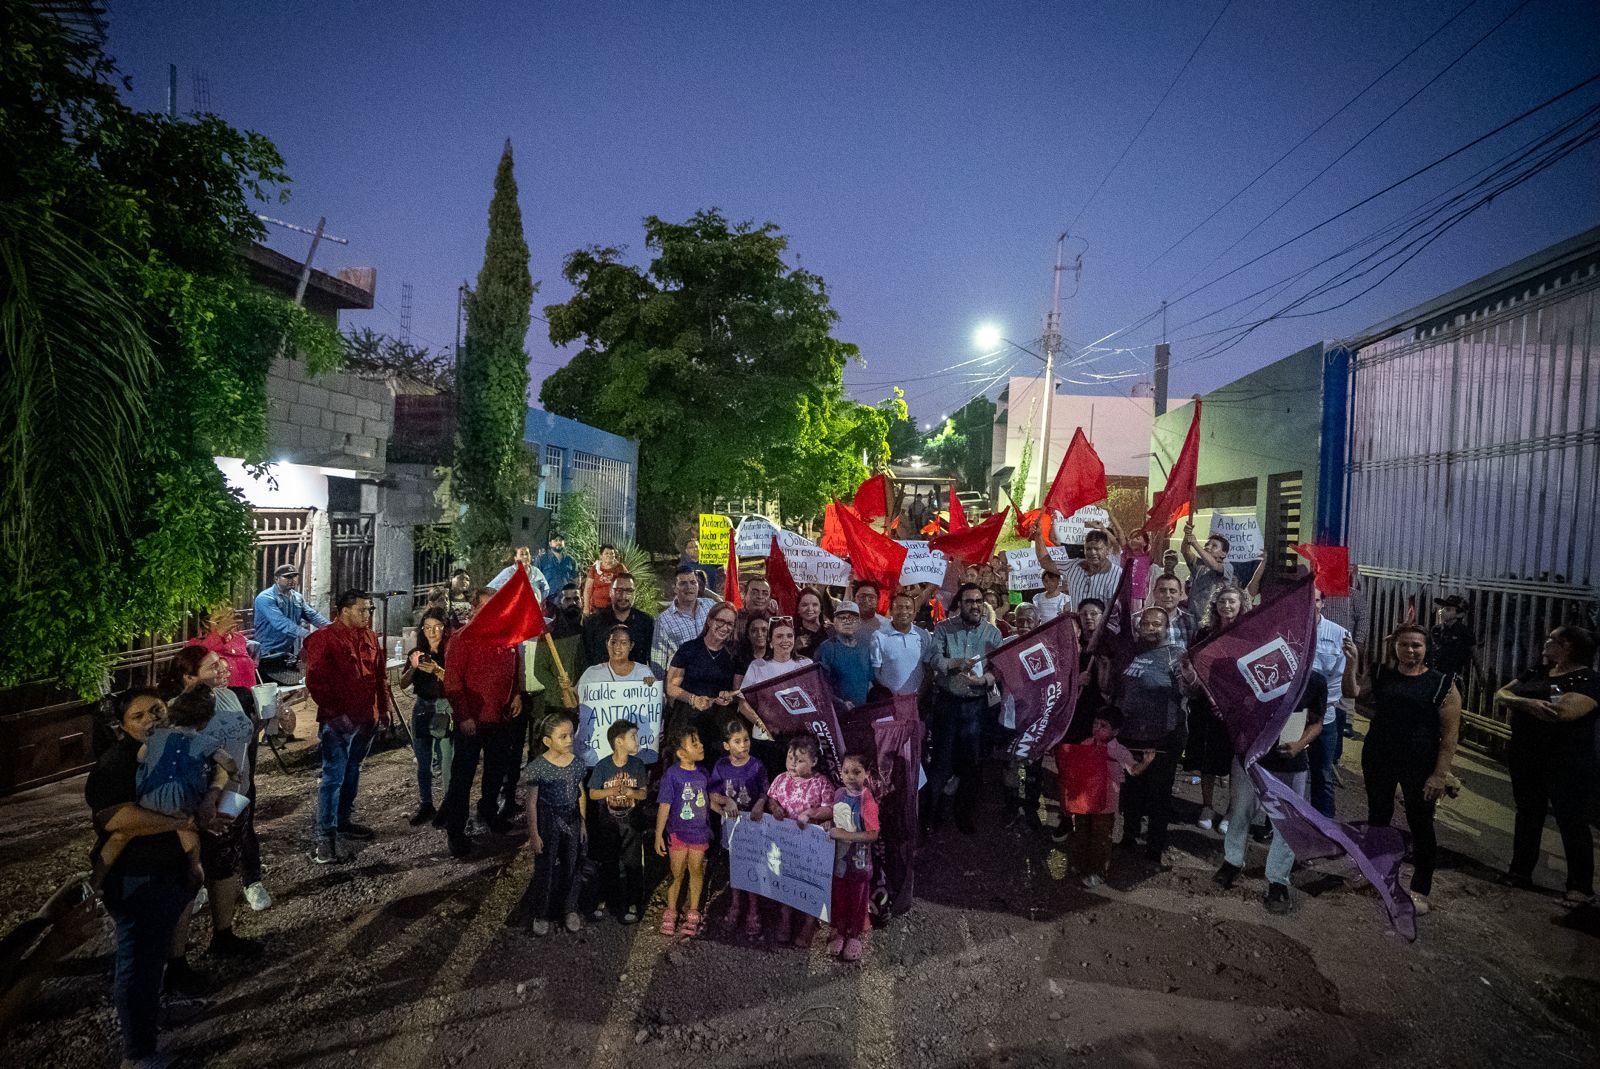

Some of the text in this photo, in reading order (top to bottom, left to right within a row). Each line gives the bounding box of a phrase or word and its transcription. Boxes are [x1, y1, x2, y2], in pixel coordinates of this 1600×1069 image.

[1217, 518, 1257, 530] Antorcha
[1065, 534, 1086, 543] ANTO
[817, 561, 841, 574] para
[793, 570, 818, 582] estros
[583, 683, 658, 702] Alcalde amigo
[747, 867, 817, 905] Gracias
